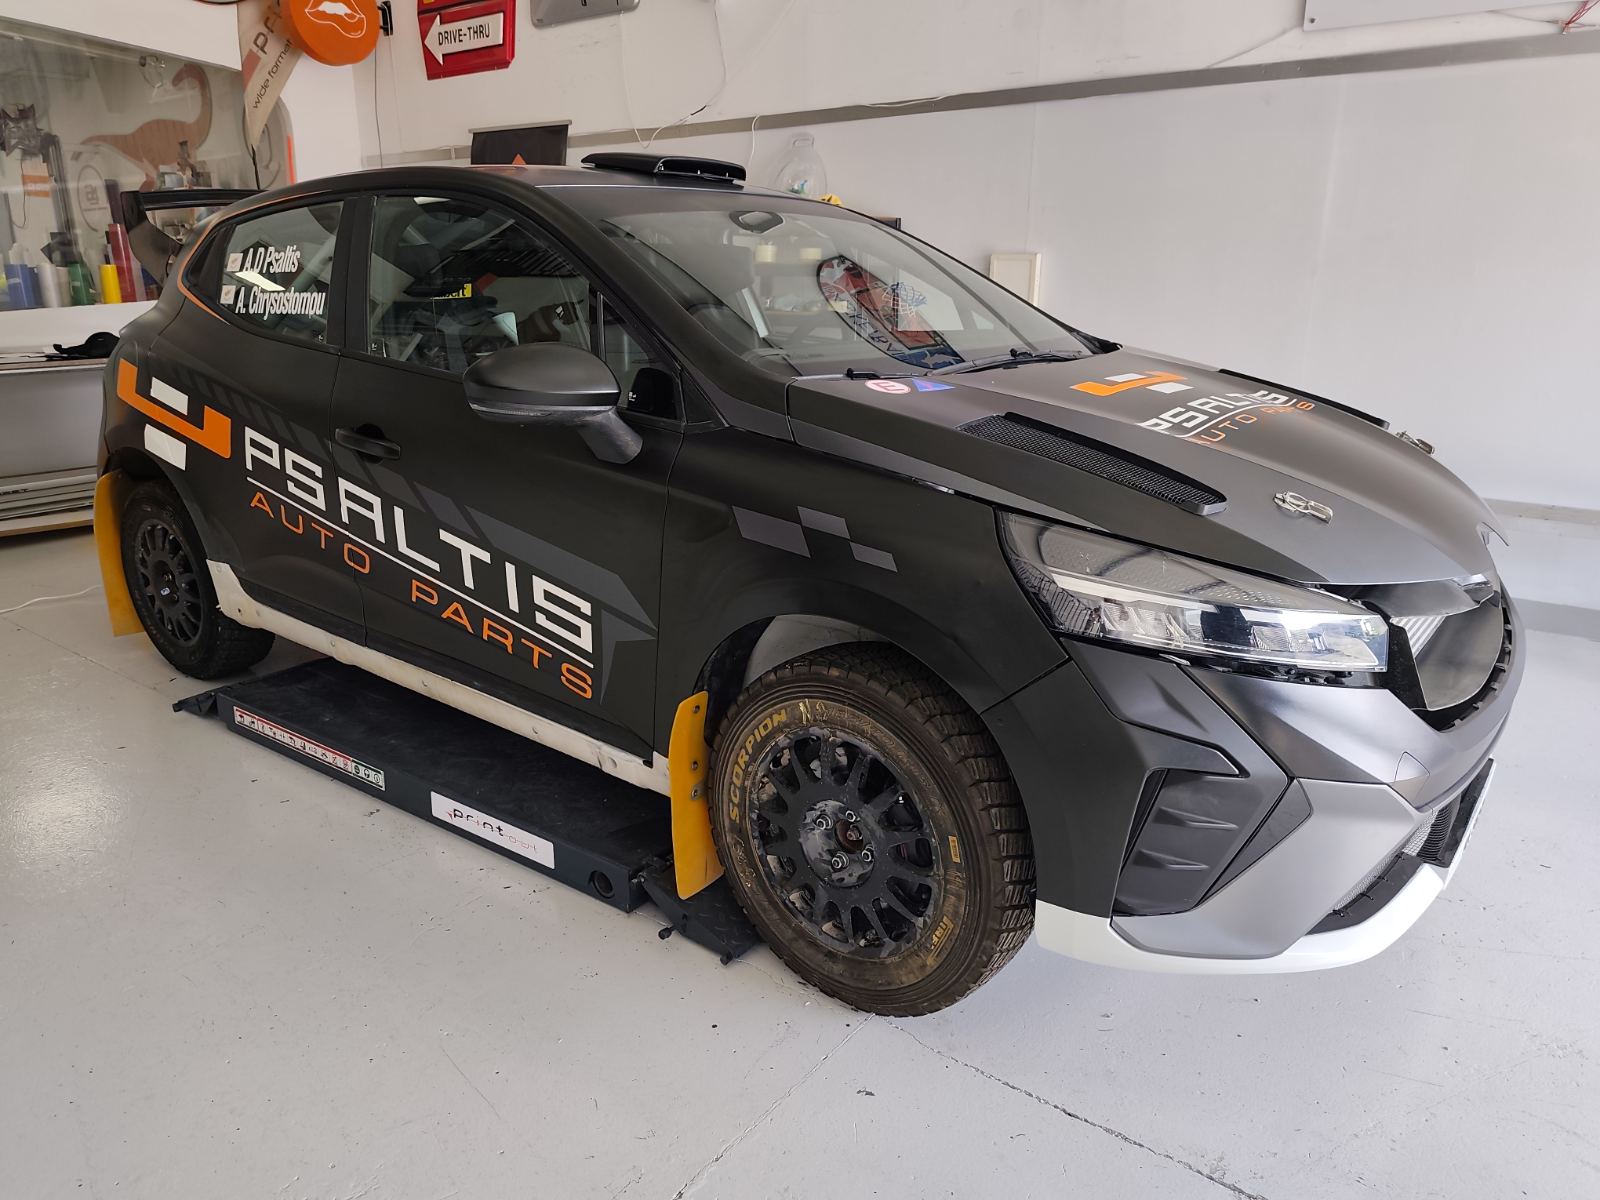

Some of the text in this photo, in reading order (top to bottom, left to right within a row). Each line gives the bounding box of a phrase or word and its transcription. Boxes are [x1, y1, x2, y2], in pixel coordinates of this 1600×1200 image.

[438, 23, 491, 46] DRIVE-THRU
[253, 39, 293, 109] wide format
[262, 245, 301, 274] Psaltis
[235, 286, 326, 320] A. Chrysostomou
[245, 427, 593, 653] PSALTIS
[250, 490, 593, 698] AUTO PARTS
[729, 708, 788, 824] SCORPION
